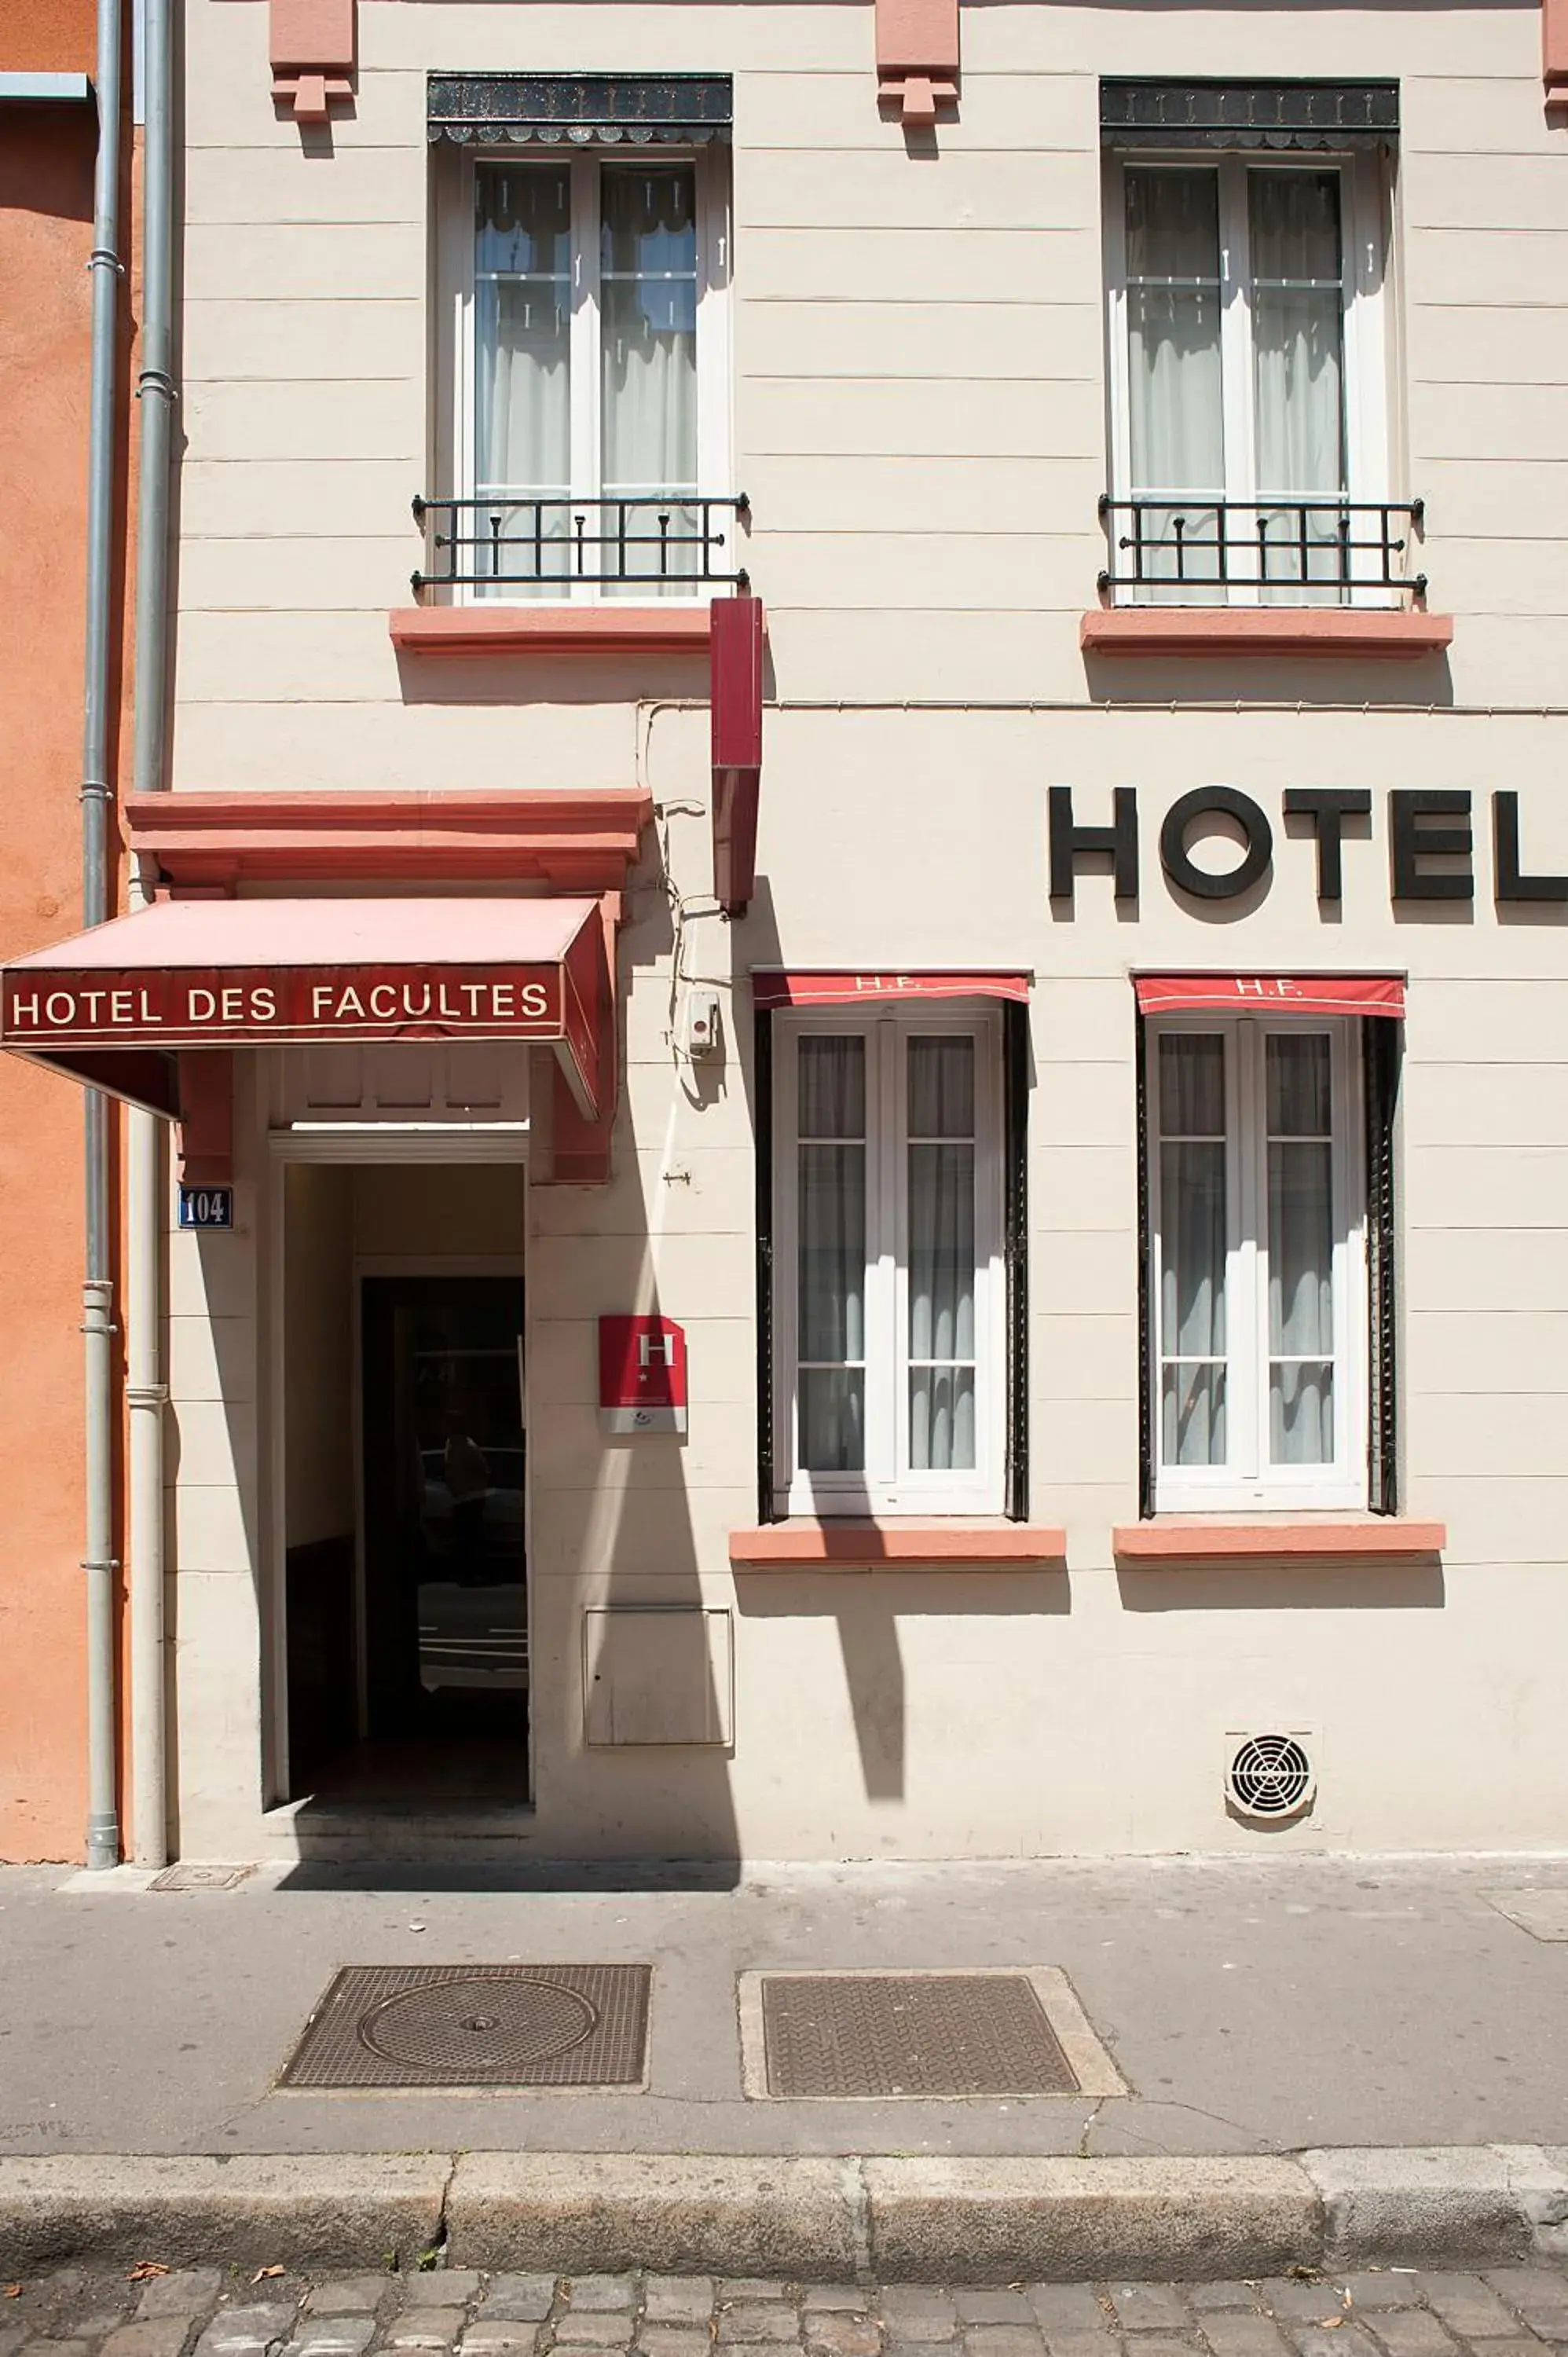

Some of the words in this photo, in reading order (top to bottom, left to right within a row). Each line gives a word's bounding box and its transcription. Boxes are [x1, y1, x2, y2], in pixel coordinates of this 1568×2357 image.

[1049, 786, 1568, 901] HOTEL
[855, 976, 921, 991] H.F.
[1236, 978, 1303, 996] H.F.
[13, 989, 163, 1025] HOTEL
[188, 988, 276, 1021] DES
[313, 984, 548, 1019] FACULTES
[186, 1192, 225, 1222] 104
[636, 1333, 677, 1366] H
